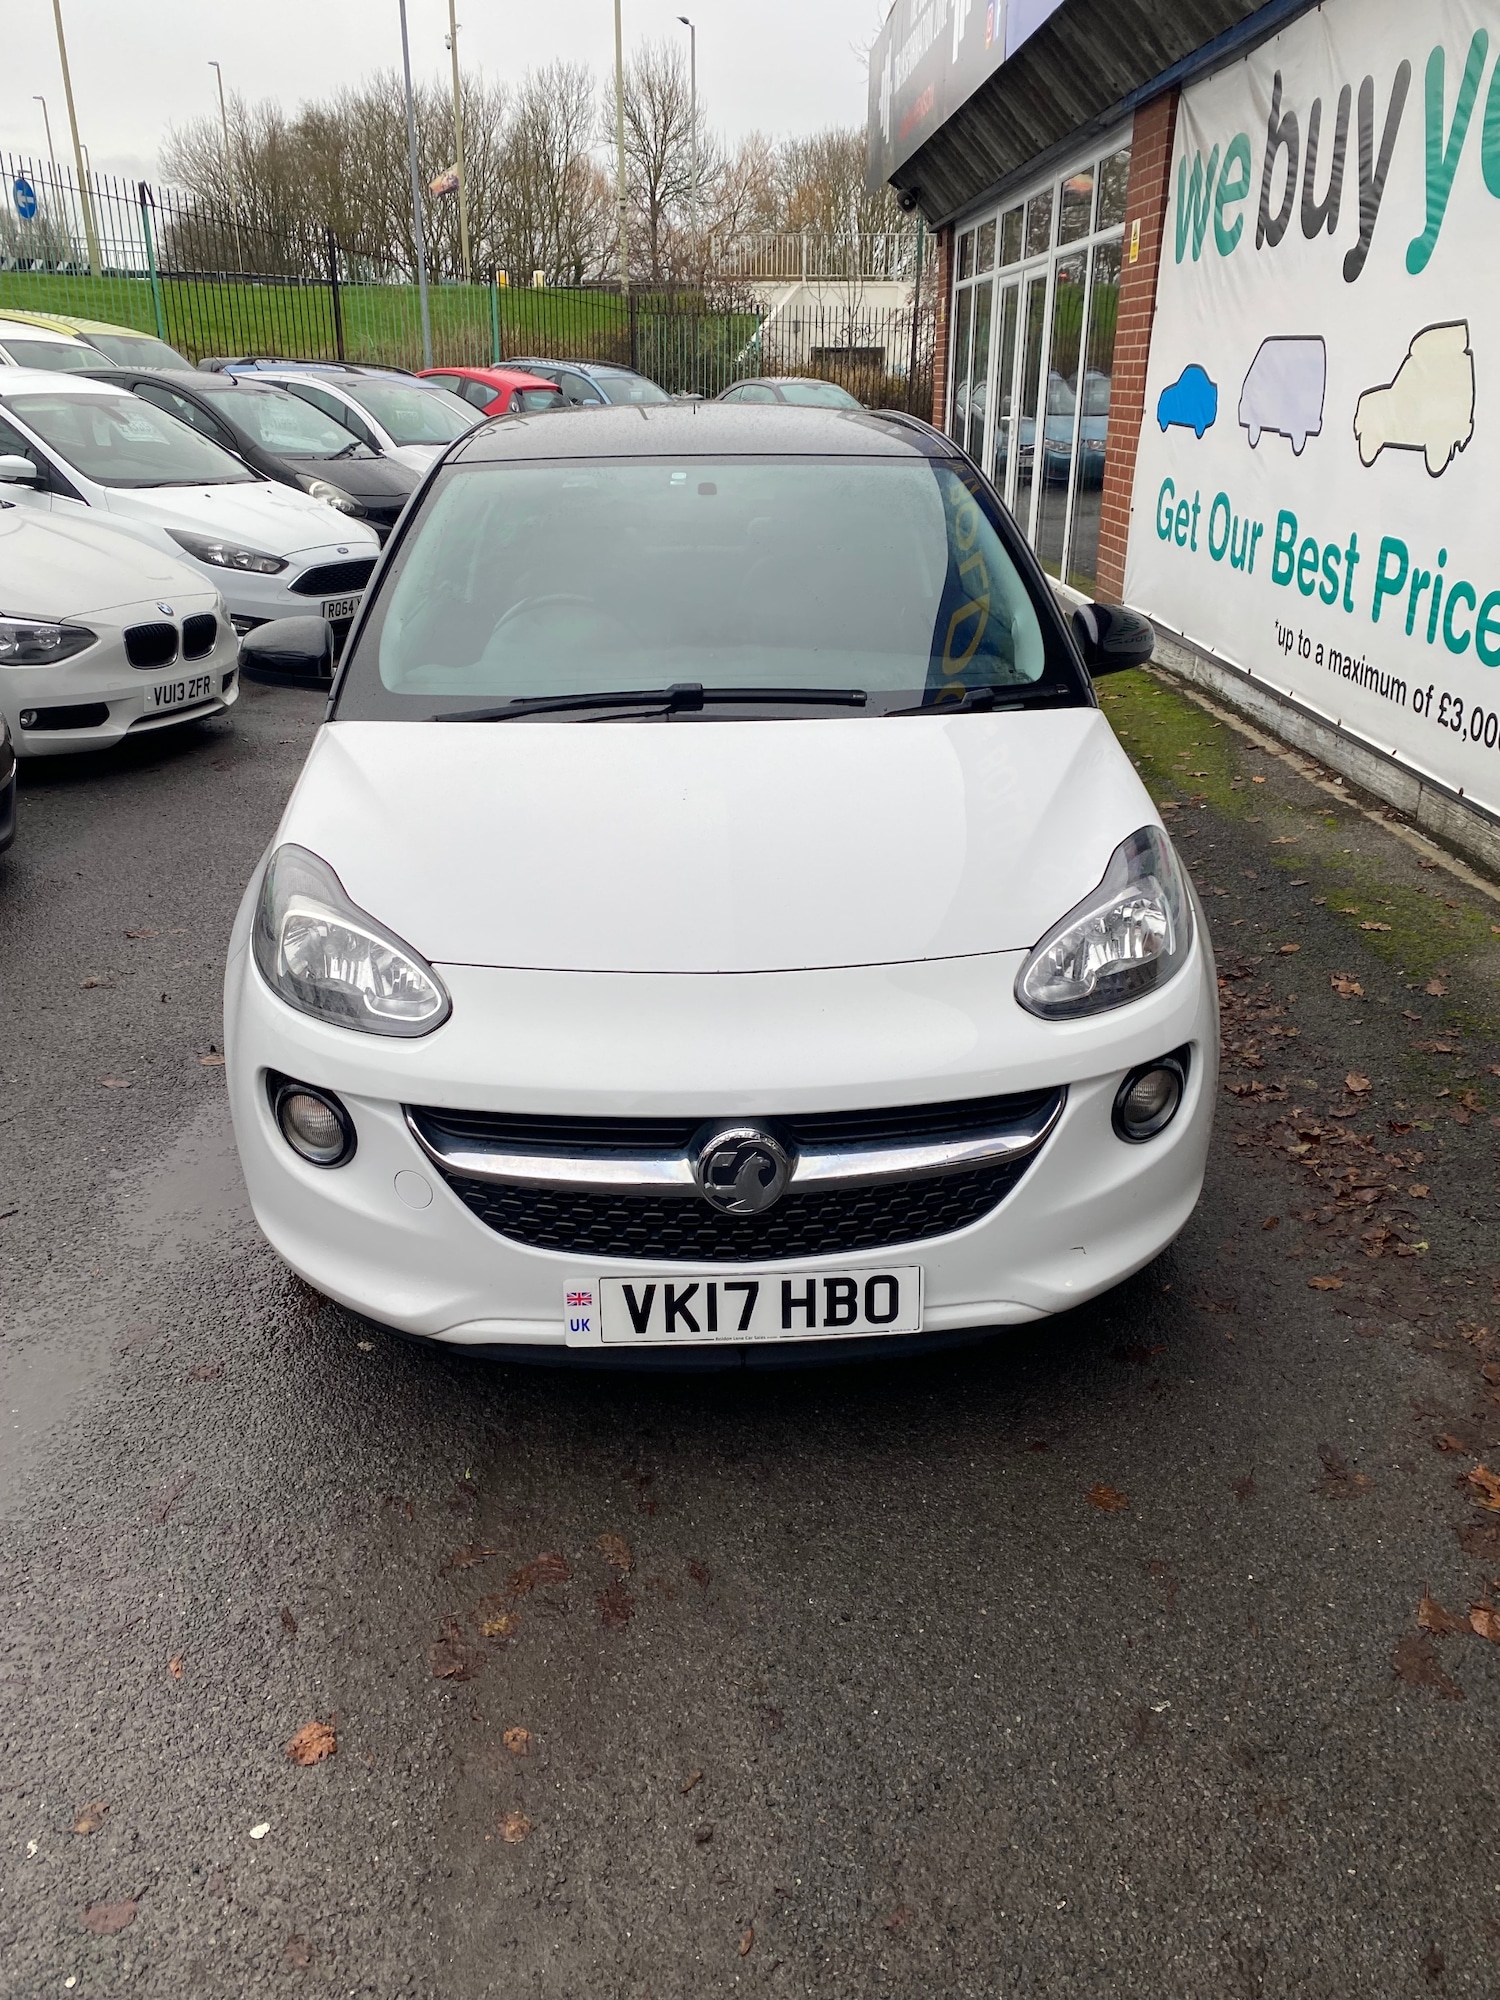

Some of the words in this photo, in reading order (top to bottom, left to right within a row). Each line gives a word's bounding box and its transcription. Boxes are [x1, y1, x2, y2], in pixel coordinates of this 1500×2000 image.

[1175, 132, 1251, 264] we
[1256, 58, 1412, 284] buy
[1405, 28, 1500, 275] y
[1156, 477, 1201, 552] Get
[1209, 491, 1264, 574] Our
[1271, 509, 1361, 613] Best
[154, 682, 185, 706] VU13
[188, 675, 211, 699] ZFR
[1298, 629, 1311, 659] to
[1315, 643, 1324, 667] a
[1328, 648, 1407, 707] maximum
[1412, 684, 1436, 718] of
[1437, 692, 1500, 752] £3,00
[570, 1318, 591, 1332] UK
[622, 1281, 760, 1333] VK17
[781, 1275, 900, 1330] HBO
